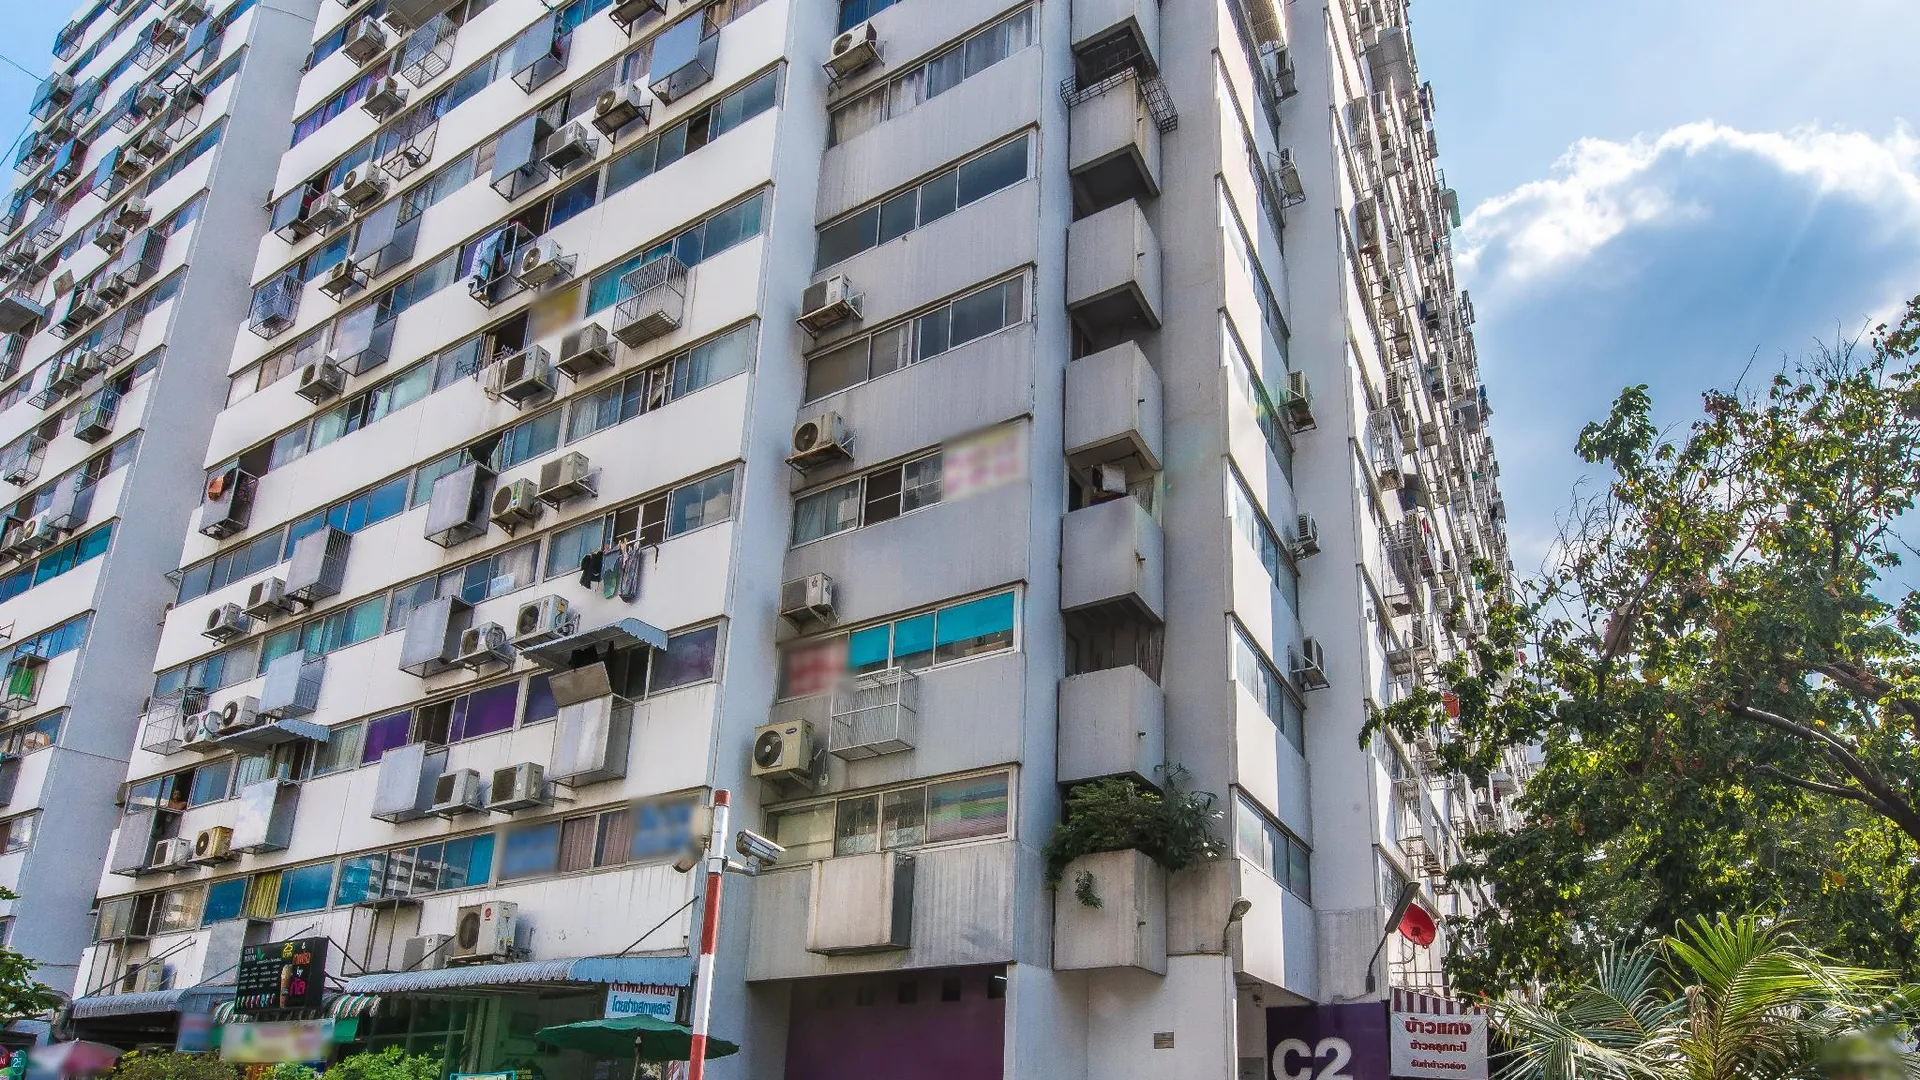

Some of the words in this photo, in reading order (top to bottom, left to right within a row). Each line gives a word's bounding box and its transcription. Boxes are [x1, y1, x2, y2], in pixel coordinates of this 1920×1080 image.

[1405, 1017, 1472, 1035] ข้าวแกง
[1272, 1037, 1353, 1080] C2
